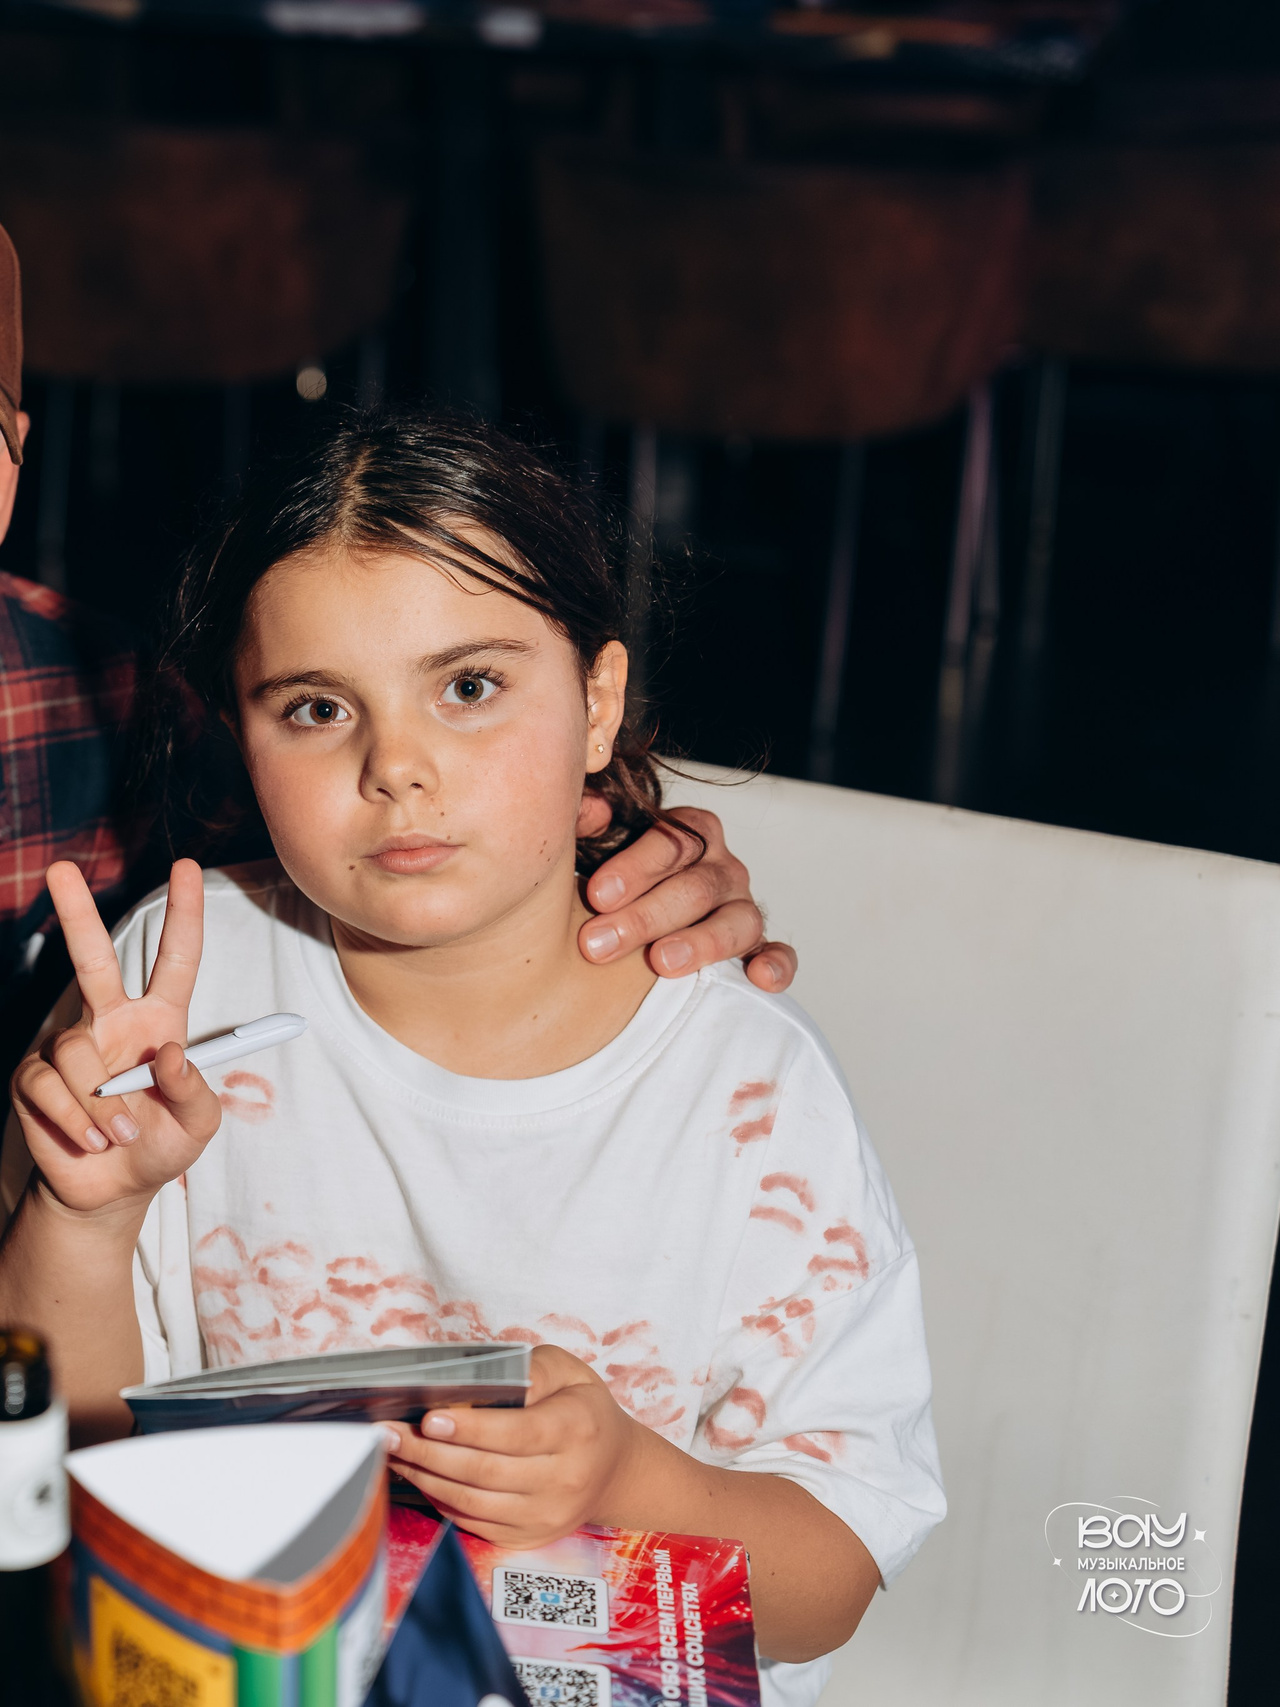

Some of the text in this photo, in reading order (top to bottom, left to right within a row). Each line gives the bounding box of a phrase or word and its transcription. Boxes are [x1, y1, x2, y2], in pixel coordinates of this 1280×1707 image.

[654, 1548, 675, 1611] ПЕРВЫМ
[658, 1611, 678, 1660] ВСЕМ
[681, 1581, 708, 1707] ШИХ СОЦСЕТЯХ
[661, 1660, 681, 1700] ОБО
